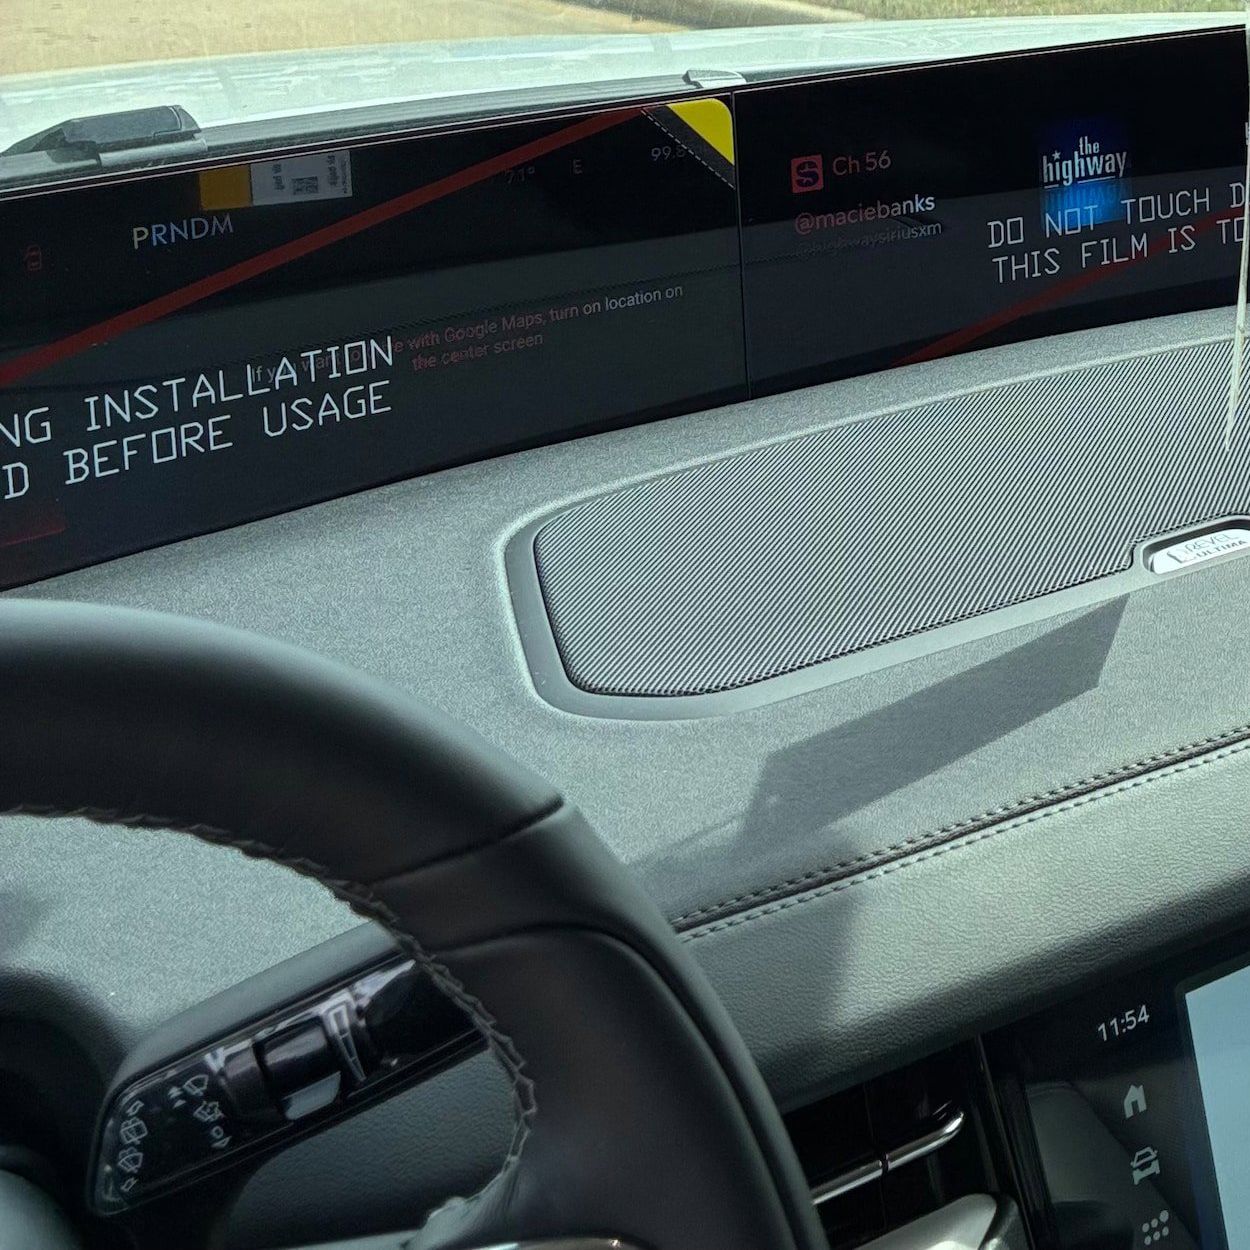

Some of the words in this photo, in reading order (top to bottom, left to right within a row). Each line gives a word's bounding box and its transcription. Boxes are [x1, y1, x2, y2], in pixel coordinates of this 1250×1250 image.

[832, 155, 860, 176] Ch
[864, 150, 892, 172] 56
[1078, 135, 1100, 156] the
[1042, 150, 1127, 187] highway
[132, 212, 234, 250] PRNDM
[794, 194, 936, 235] @maciebanks
[987, 216, 1024, 249] DO
[1045, 204, 1098, 239] NOT
[1121, 187, 1210, 225] TOUCH
[992, 247, 1060, 284] THIS
[1081, 232, 1149, 269] FILM
[1168, 224, 1196, 255] IS
[1216, 216, 1249, 246] TO
[408, 331, 439, 351] with
[444, 318, 498, 343] Google
[502, 311, 546, 332] Maps,
[550, 305, 579, 323] turn
[583, 300, 601, 316] on
[605, 290, 661, 311] location
[665, 285, 684, 300] on
[412, 352, 436, 371] the
[441, 345, 489, 366] center
[493, 333, 543, 355] screen
[85, 335, 394, 432] INSTALLATION
[63, 414, 234, 486] BEFORE
[263, 380, 393, 438] USAGE
[1098, 1003, 1151, 1042] 11:54
